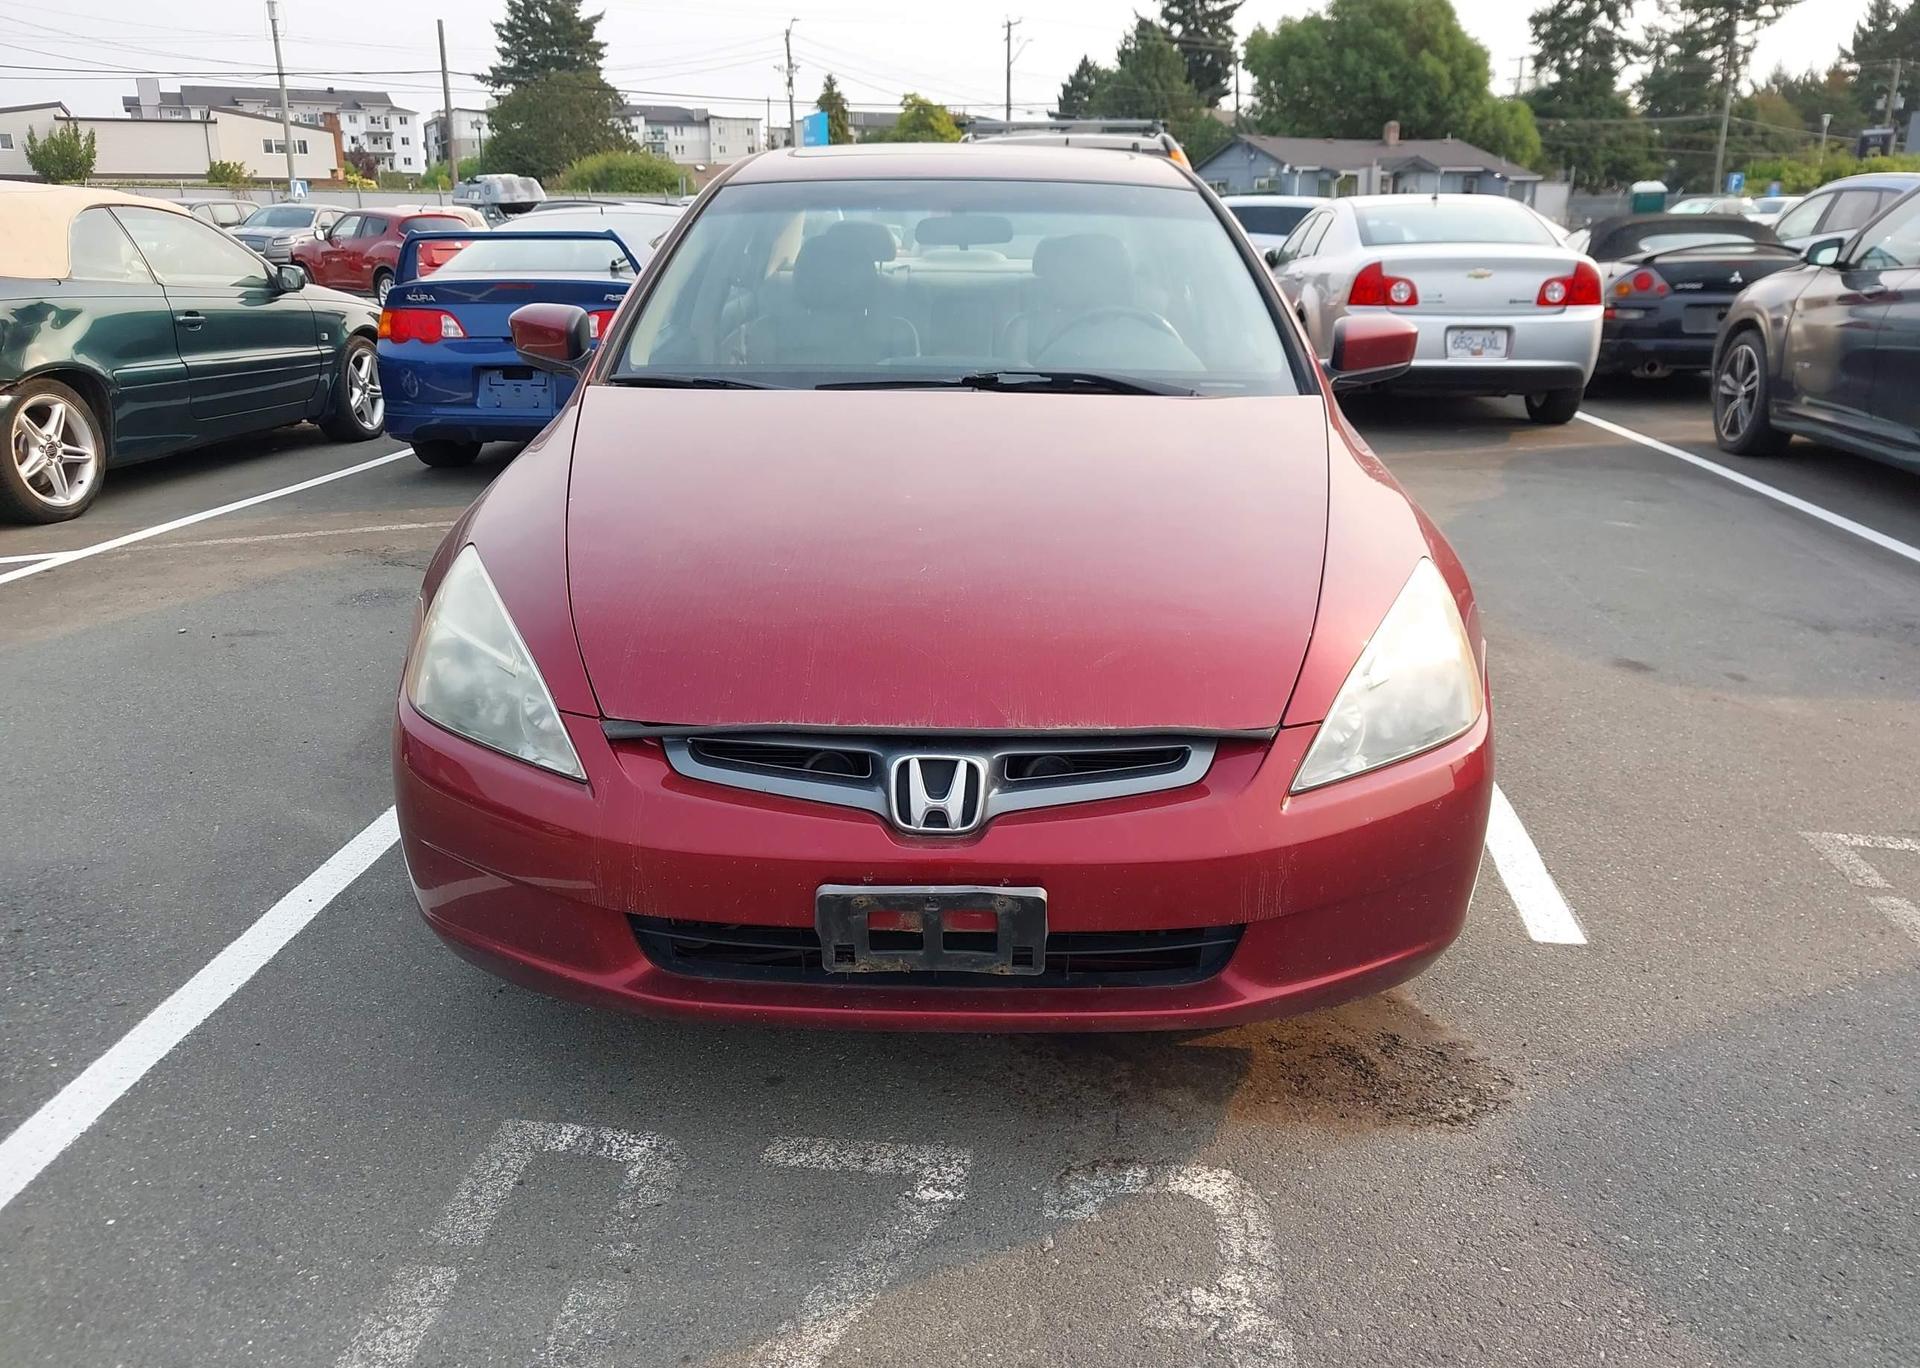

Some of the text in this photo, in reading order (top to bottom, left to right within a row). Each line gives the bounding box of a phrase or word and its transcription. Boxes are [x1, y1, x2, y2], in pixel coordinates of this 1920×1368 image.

[294, 182, 306, 198] A
[406, 294, 436, 303] ACURA
[603, 294, 627, 302] RS
